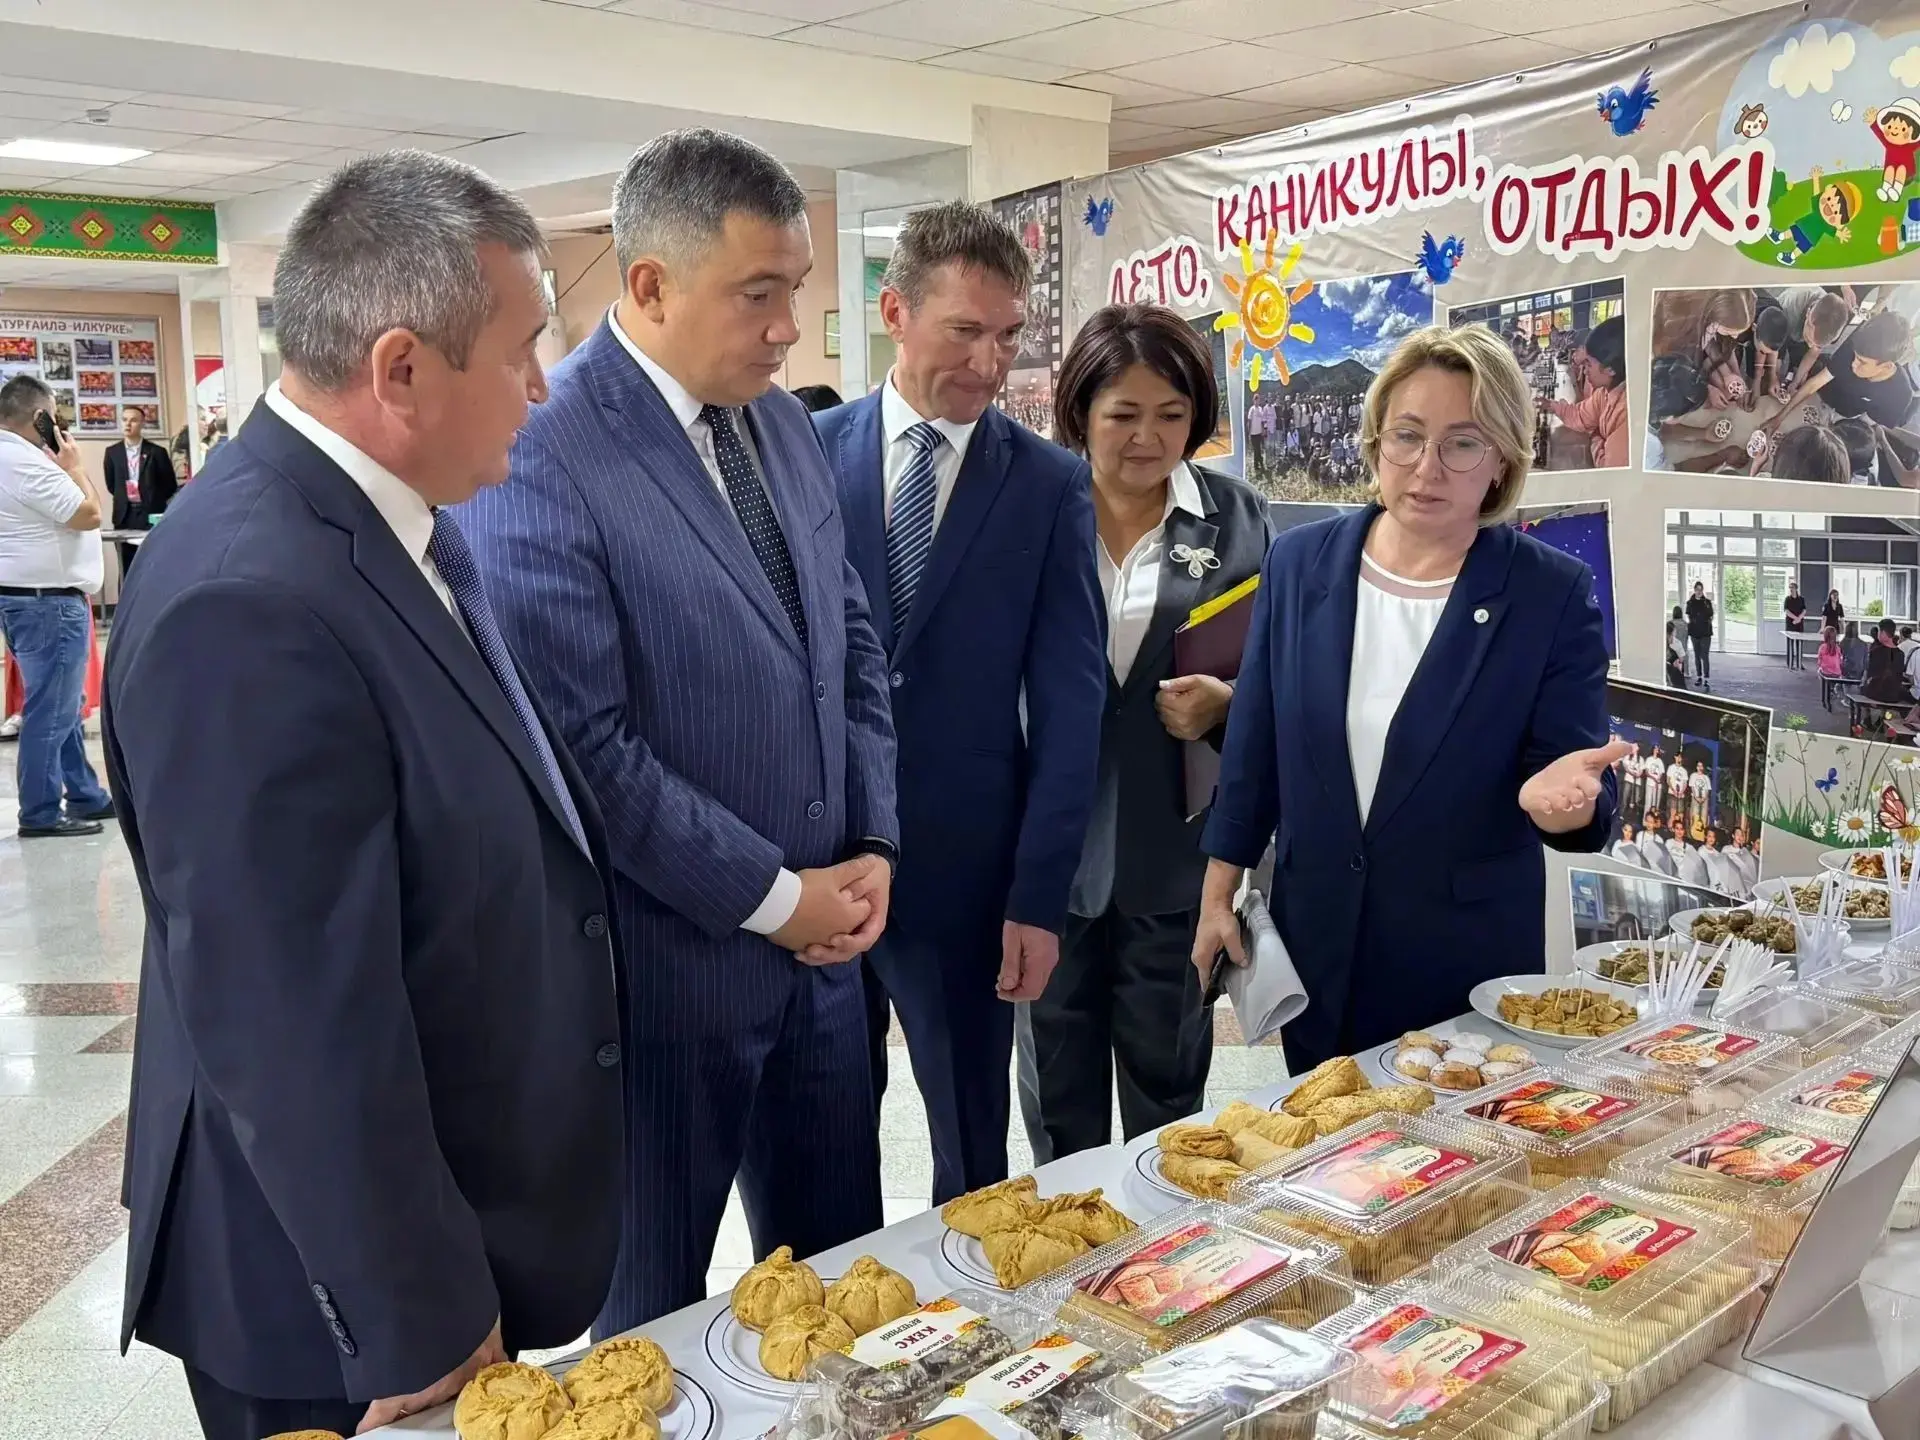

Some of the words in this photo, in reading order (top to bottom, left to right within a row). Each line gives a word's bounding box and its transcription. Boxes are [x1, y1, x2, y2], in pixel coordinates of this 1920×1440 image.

[1112, 245, 1207, 305] ЛЕТО,
[1218, 128, 1486, 252] КАНИКУЛЫ,
[1491, 151, 1763, 251] ОТДЫХ!
[1616, 1225, 1654, 1245] Слойки
[879, 1317, 922, 1341] ВЕЧЕРНИЙ
[894, 1325, 938, 1350] КЕКС
[1440, 1343, 1475, 1363] Слойка
[989, 1354, 1035, 1381] ВЕЧЕРНИЙ
[1006, 1361, 1052, 1389] КЕКС
